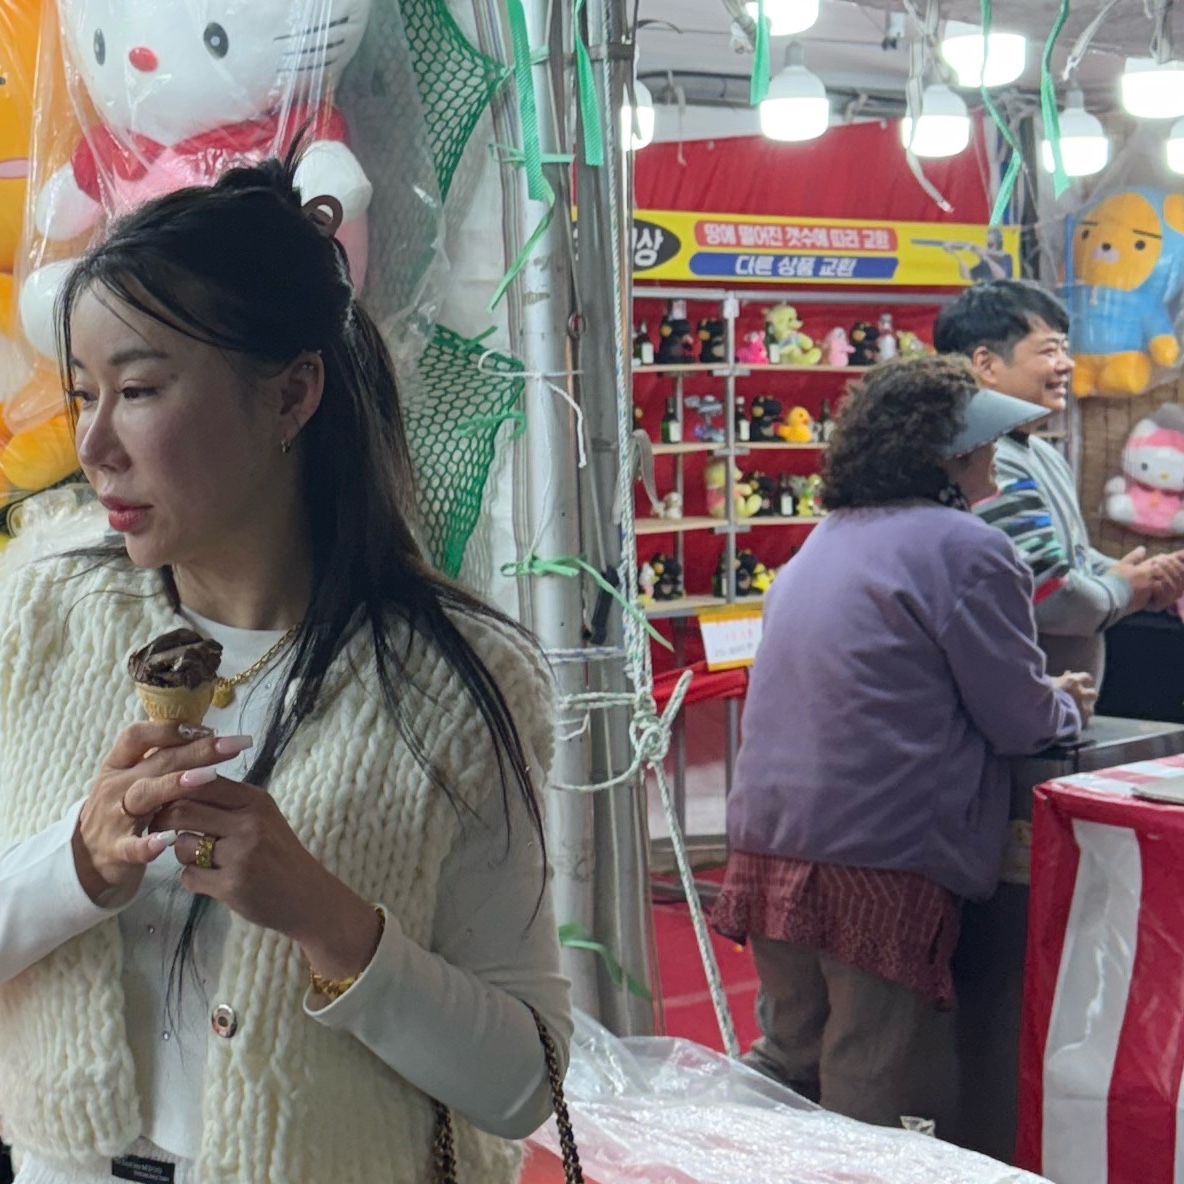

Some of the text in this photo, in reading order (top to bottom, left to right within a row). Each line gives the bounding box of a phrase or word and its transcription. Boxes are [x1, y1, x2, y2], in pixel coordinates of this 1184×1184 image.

[632, 225, 665, 268] 상
[703, 222, 891, 251] 땅에 떨어진 갯수에 따라 교환
[734, 255, 858, 278] 다른 상품 교환
